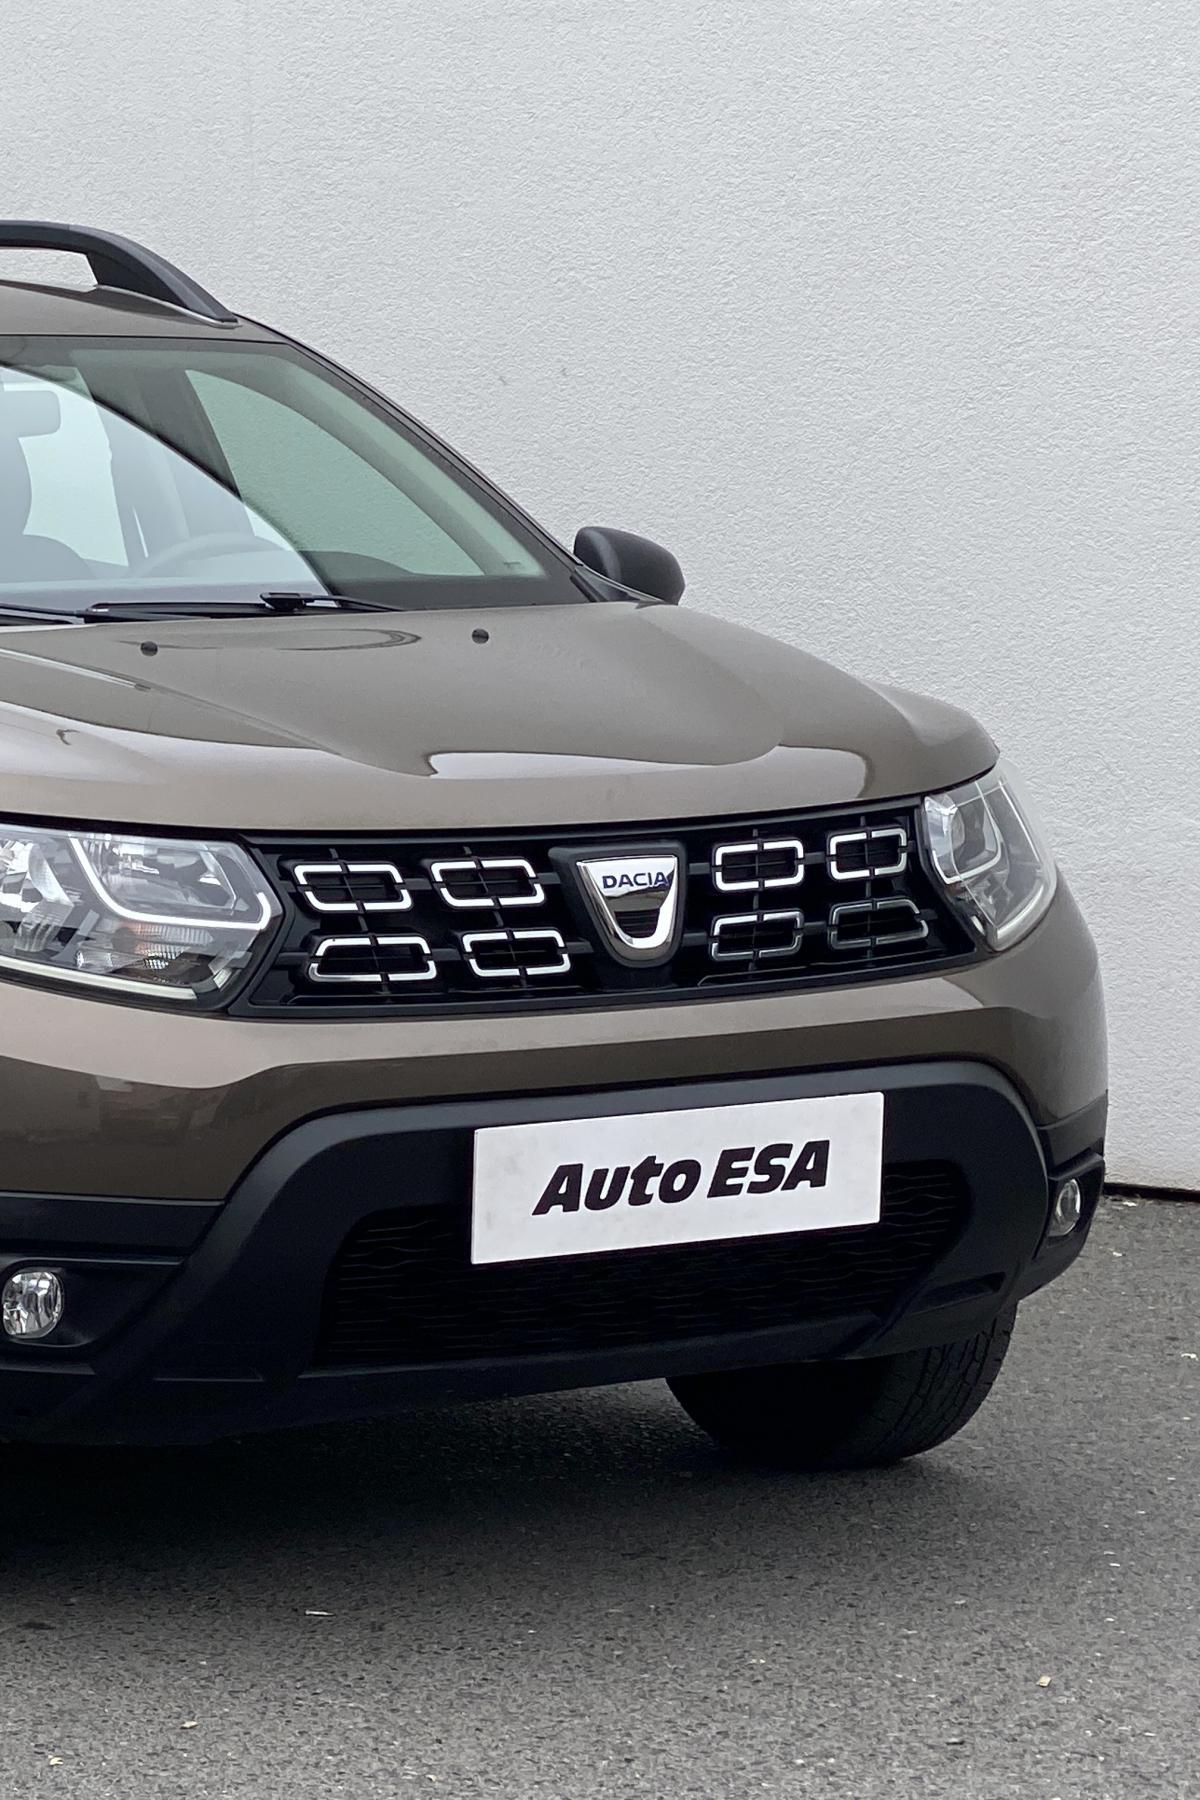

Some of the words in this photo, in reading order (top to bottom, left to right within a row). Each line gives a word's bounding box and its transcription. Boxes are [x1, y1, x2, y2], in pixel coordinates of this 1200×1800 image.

[602, 871, 669, 889] DACIA
[531, 1155, 701, 1215] Auto
[707, 1139, 830, 1199] ESA
